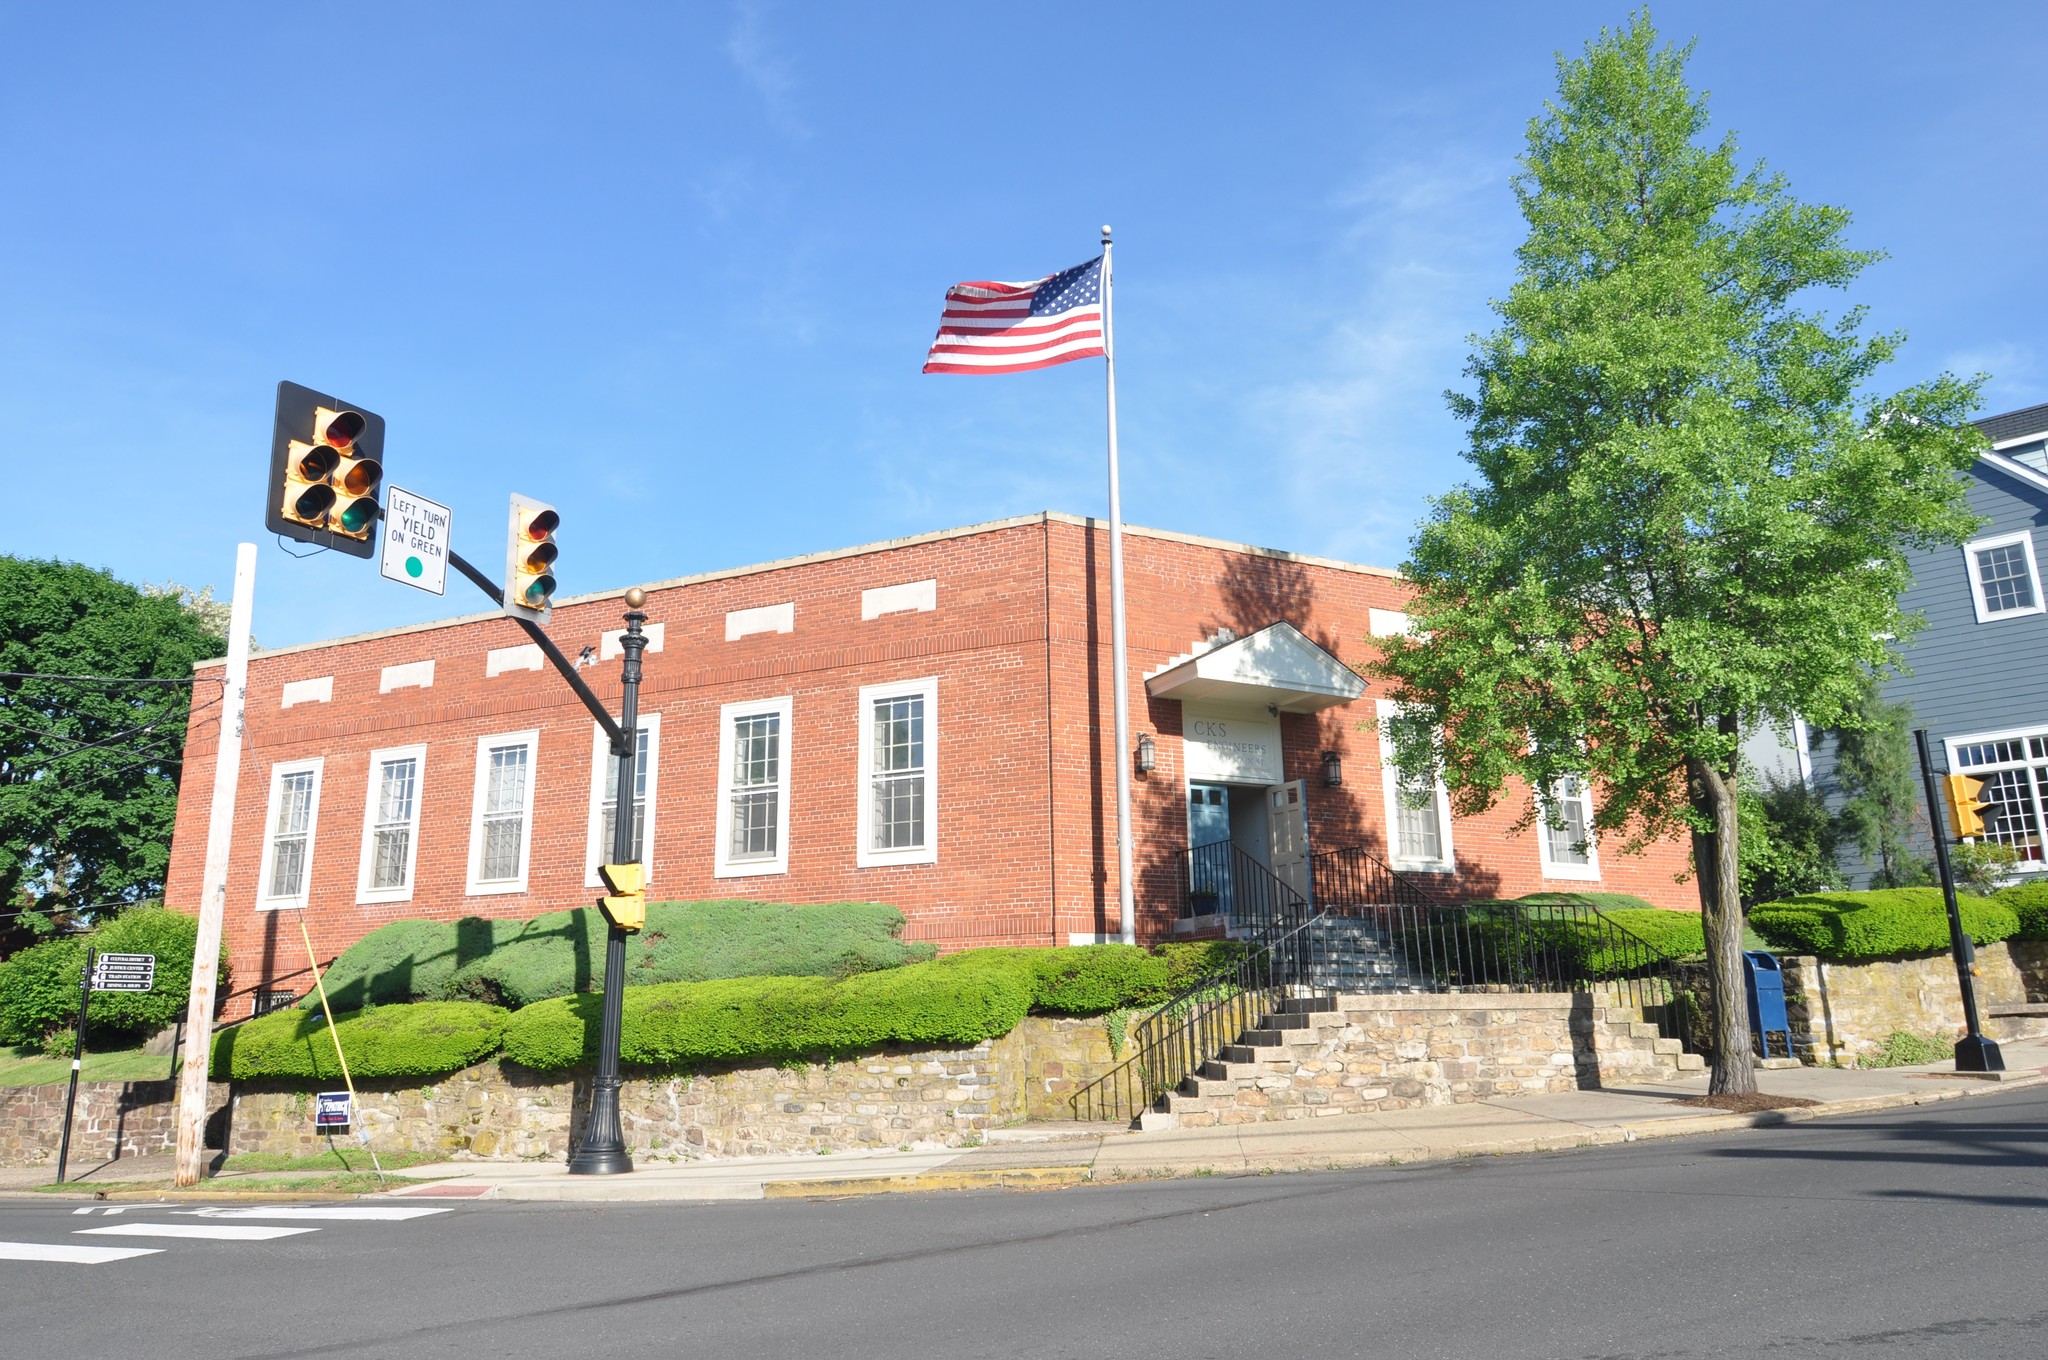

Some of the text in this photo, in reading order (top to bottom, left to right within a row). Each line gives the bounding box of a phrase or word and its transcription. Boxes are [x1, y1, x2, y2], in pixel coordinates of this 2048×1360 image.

[393, 498, 446, 528] LEFT TURN
[402, 516, 435, 540] YIELD
[391, 529, 442, 558] ON GREEN
[1194, 720, 1227, 738] CKS
[1207, 739, 1267, 755] ENGINEERS
